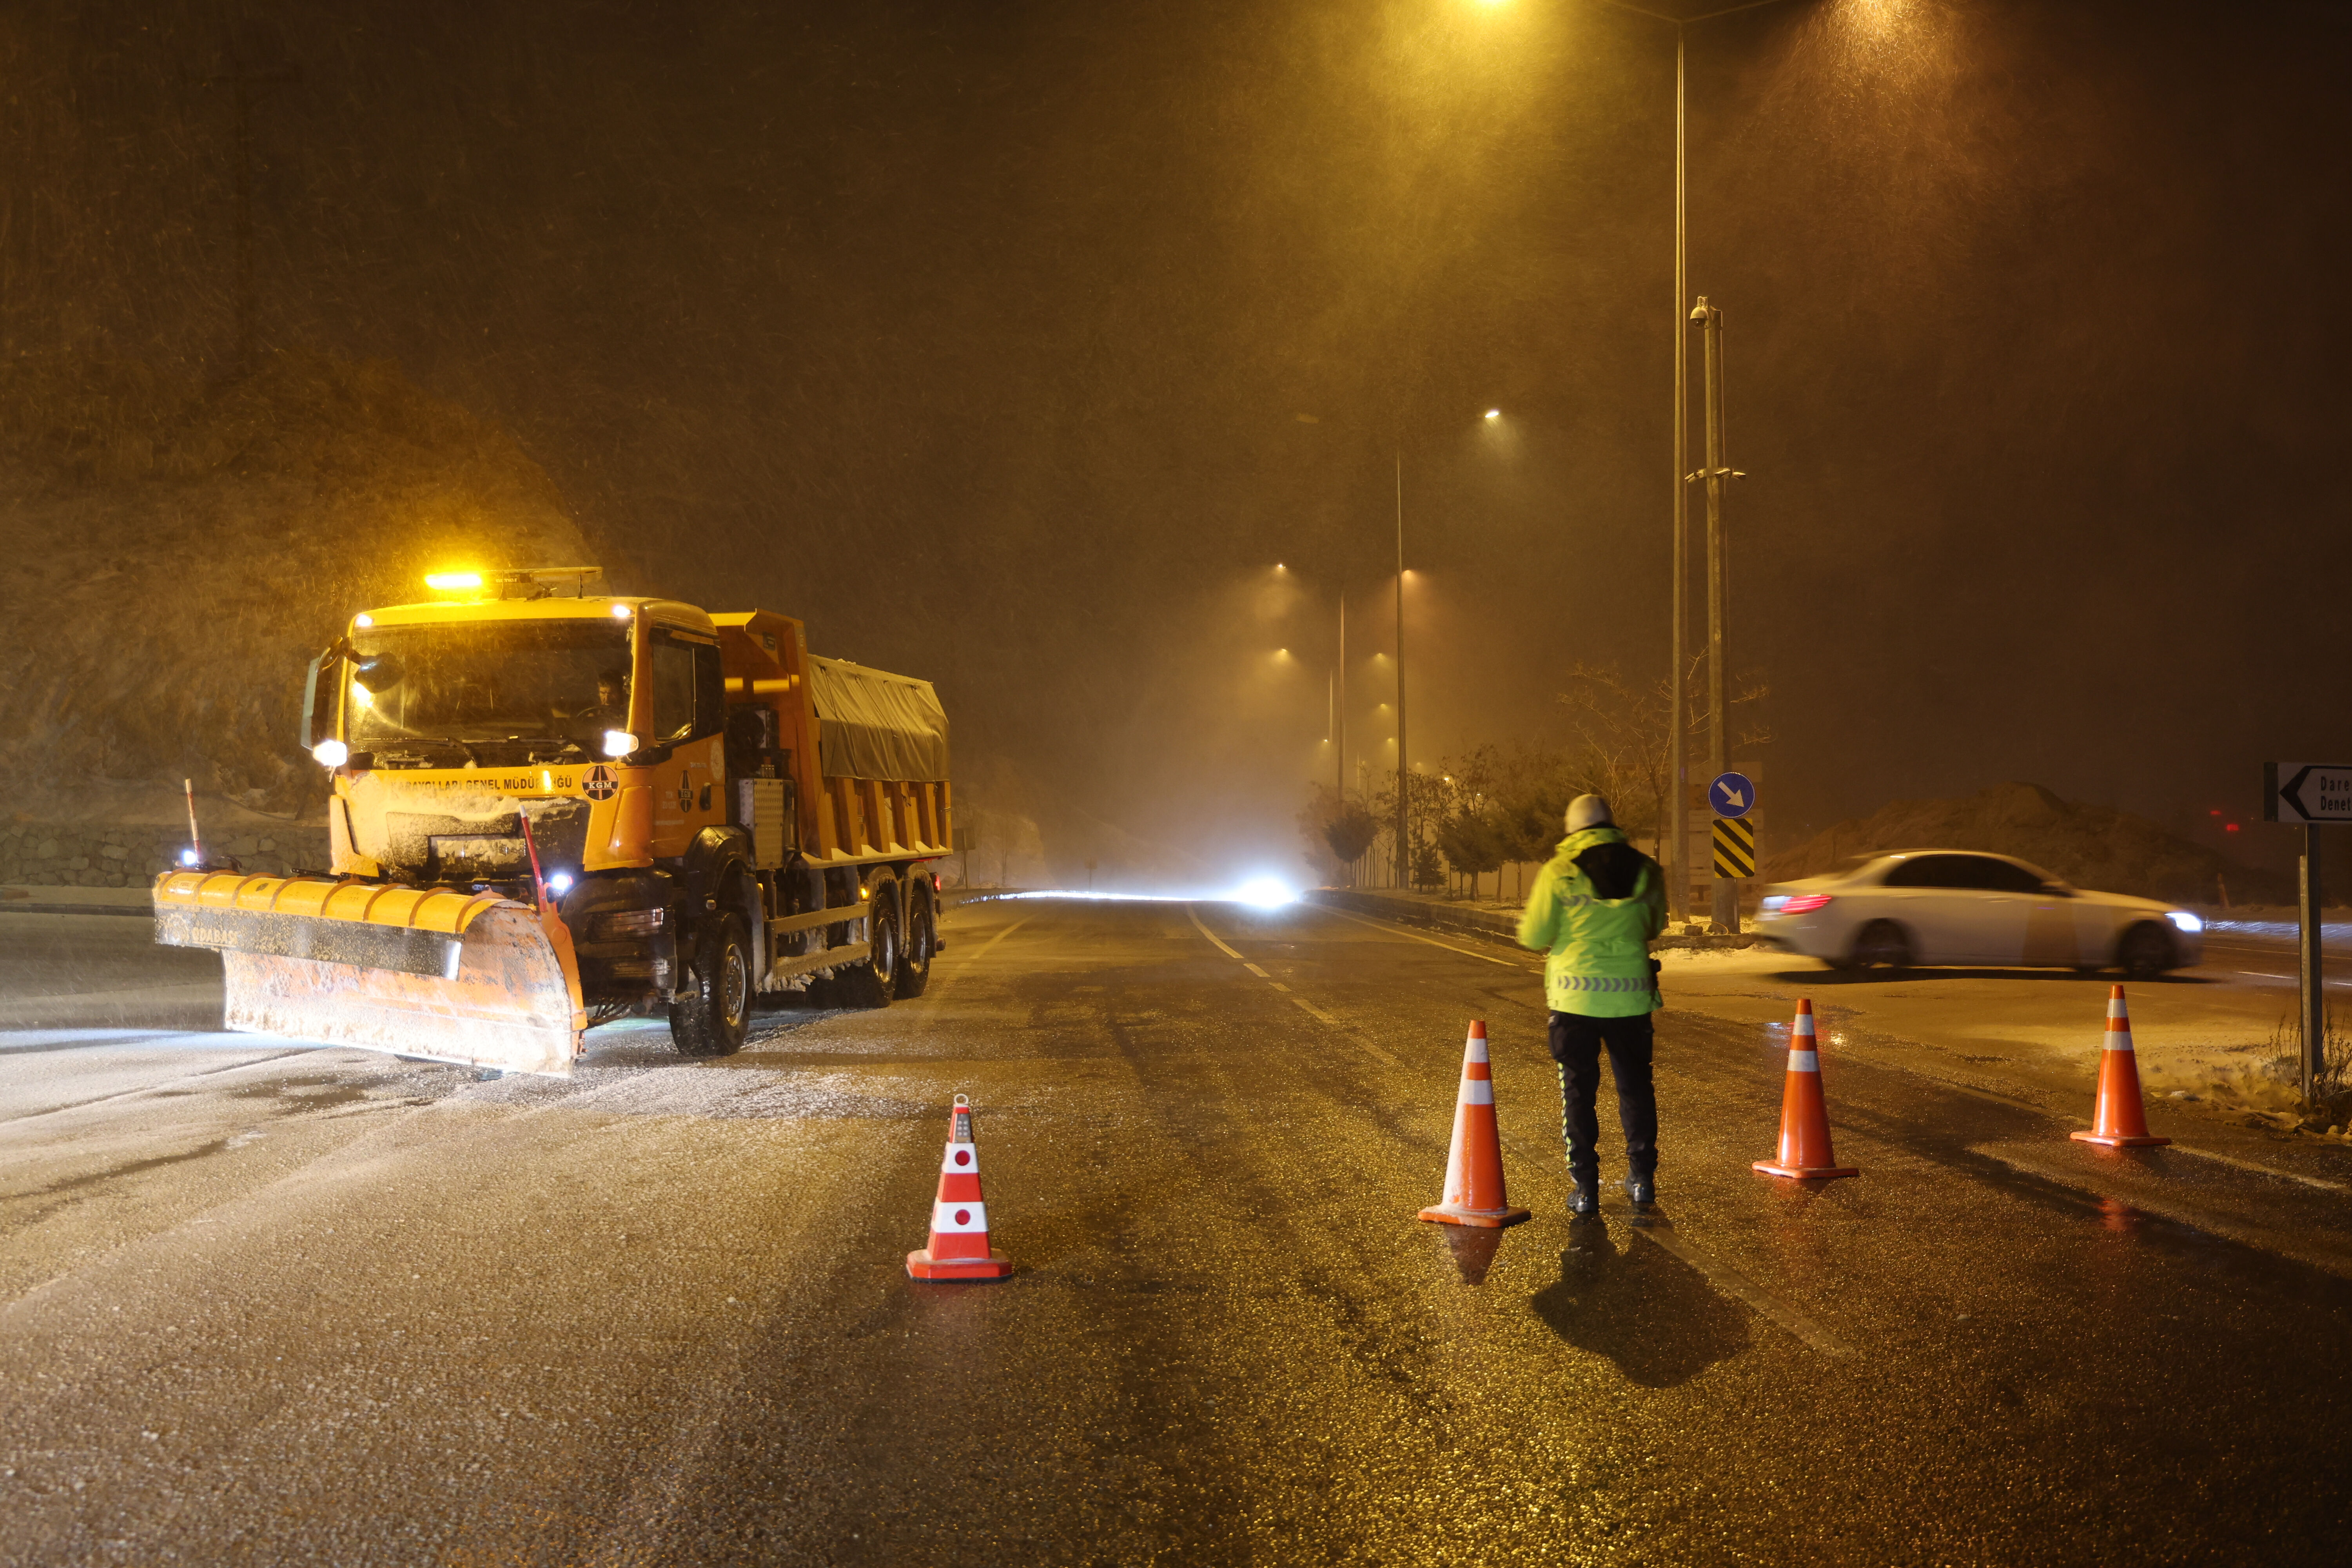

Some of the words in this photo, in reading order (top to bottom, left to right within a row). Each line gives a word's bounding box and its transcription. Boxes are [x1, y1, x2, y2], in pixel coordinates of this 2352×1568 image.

[466, 779, 501, 790] GENEL
[504, 775, 572, 789] MÜDÜRĞÜ
[2321, 776, 2350, 791] Dare
[2321, 795, 2351, 811] Denet
